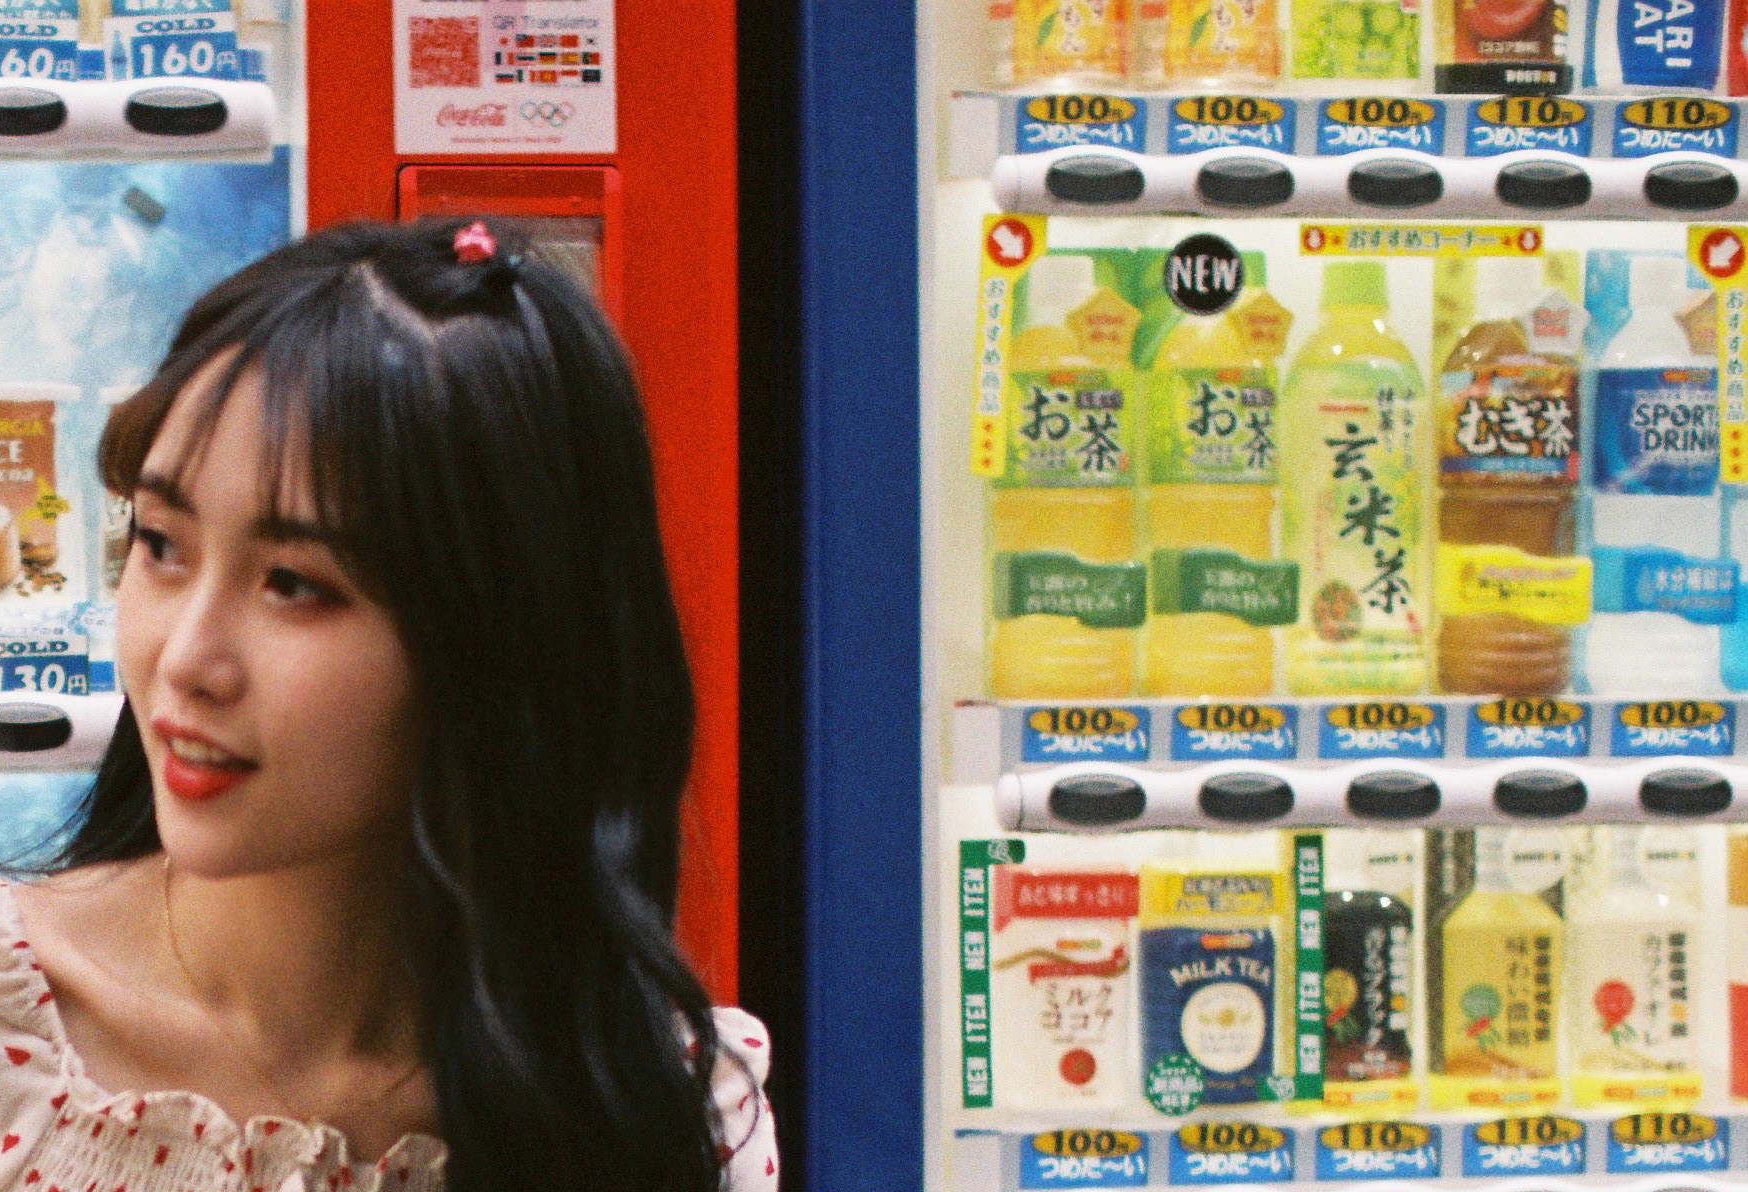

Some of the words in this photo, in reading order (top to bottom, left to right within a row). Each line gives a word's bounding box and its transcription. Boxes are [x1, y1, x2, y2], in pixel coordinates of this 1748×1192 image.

[136, 18, 217, 33] COLD
[141, 41, 236, 75] 160円
[1170, 254, 1239, 296] NEW
[1020, 384, 1121, 471] お茶
[1188, 382, 1275, 469] お茶
[1455, 396, 1575, 457] むぎ茶
[1325, 424, 1412, 614] 玄米茶
[963, 867, 986, 916] ITEM
[964, 931, 986, 970] NEW
[1170, 959, 1231, 987] MILK
[1238, 957, 1270, 984] TEA
[964, 994, 988, 1042] ITEM
[966, 1057, 988, 1096] NEW
